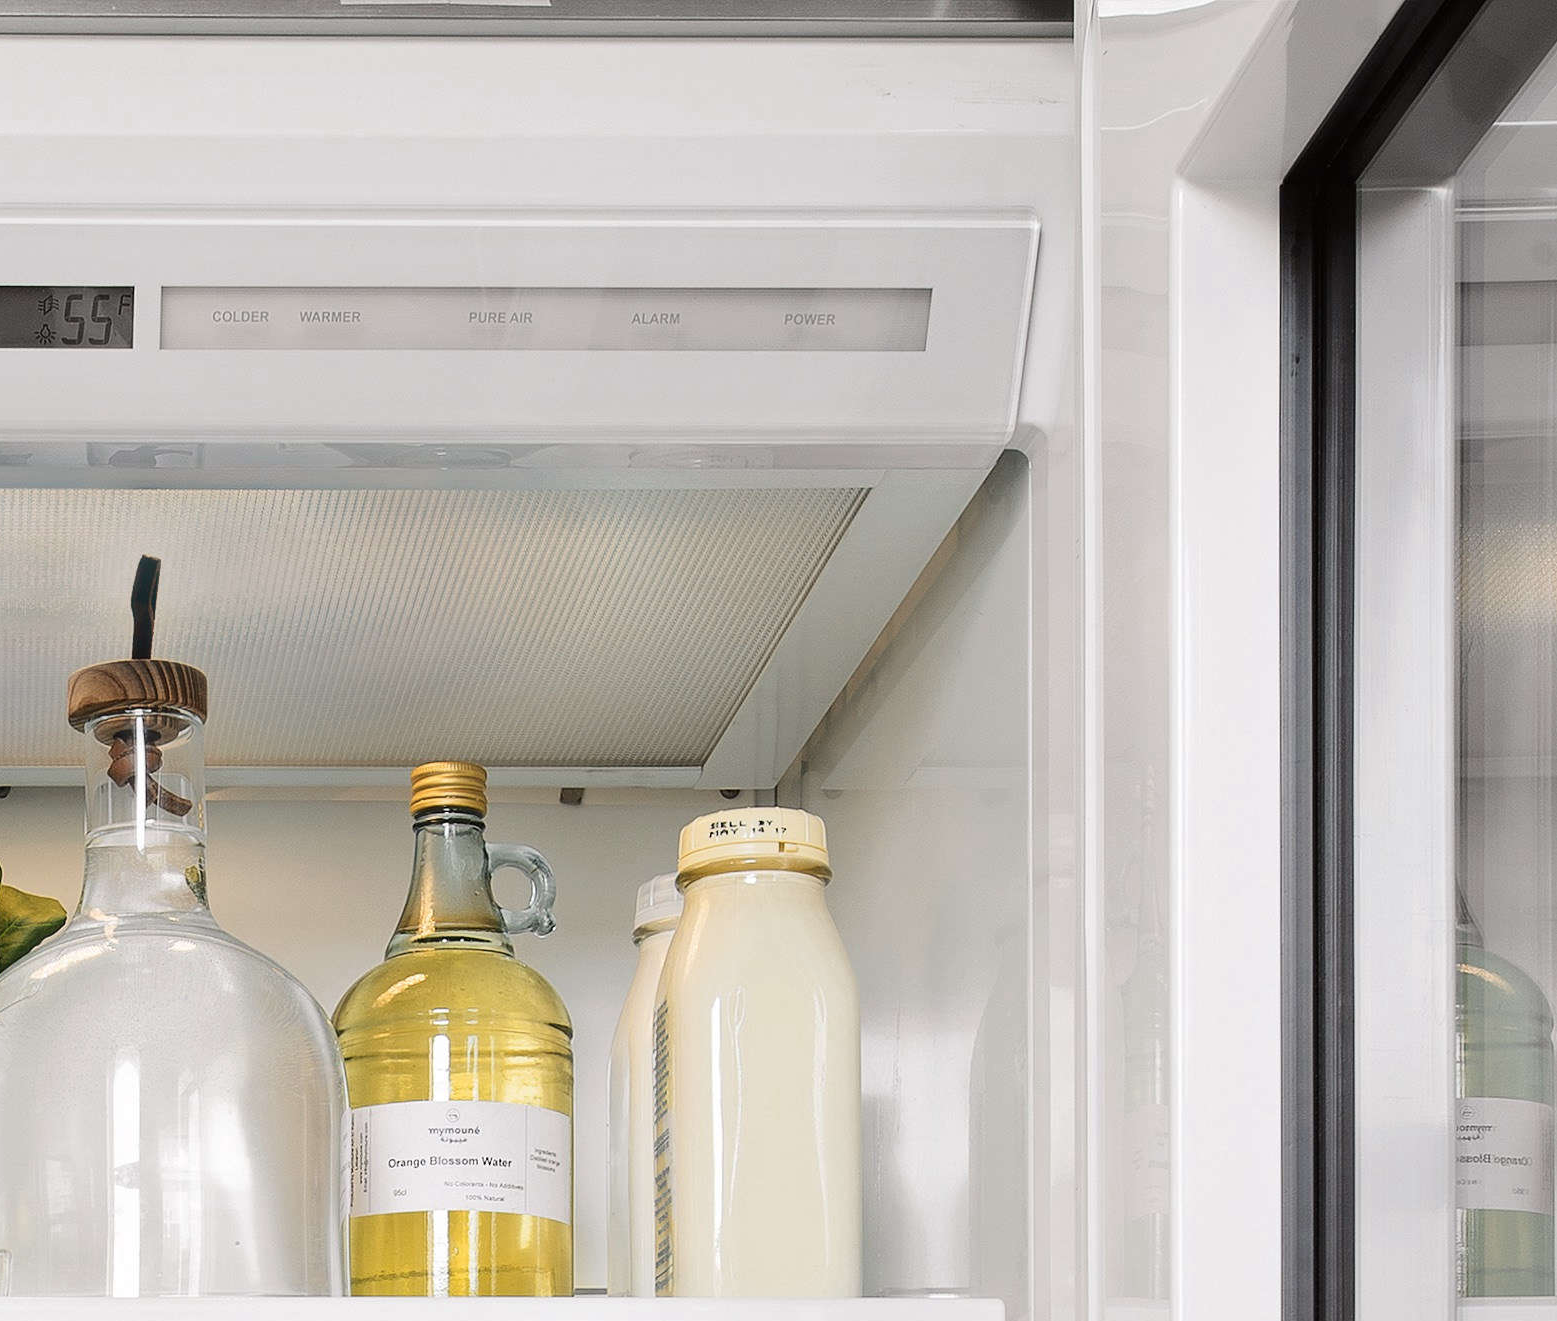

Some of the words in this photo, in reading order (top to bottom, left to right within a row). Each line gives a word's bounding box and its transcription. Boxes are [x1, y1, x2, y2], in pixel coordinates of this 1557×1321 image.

[212, 310, 270, 323] COLDER
[299, 311, 362, 323] WARMER
[468, 312, 507, 324] PURE
[509, 312, 534, 324] AIR
[631, 312, 681, 325] ALARM
[784, 313, 836, 326] POWER
[709, 828, 739, 838] MAY
[428, 1126, 481, 1137] mymouné
[388, 1158, 427, 1169] Orange
[429, 1156, 479, 1166] Blossom
[481, 1156, 513, 1168] Water
